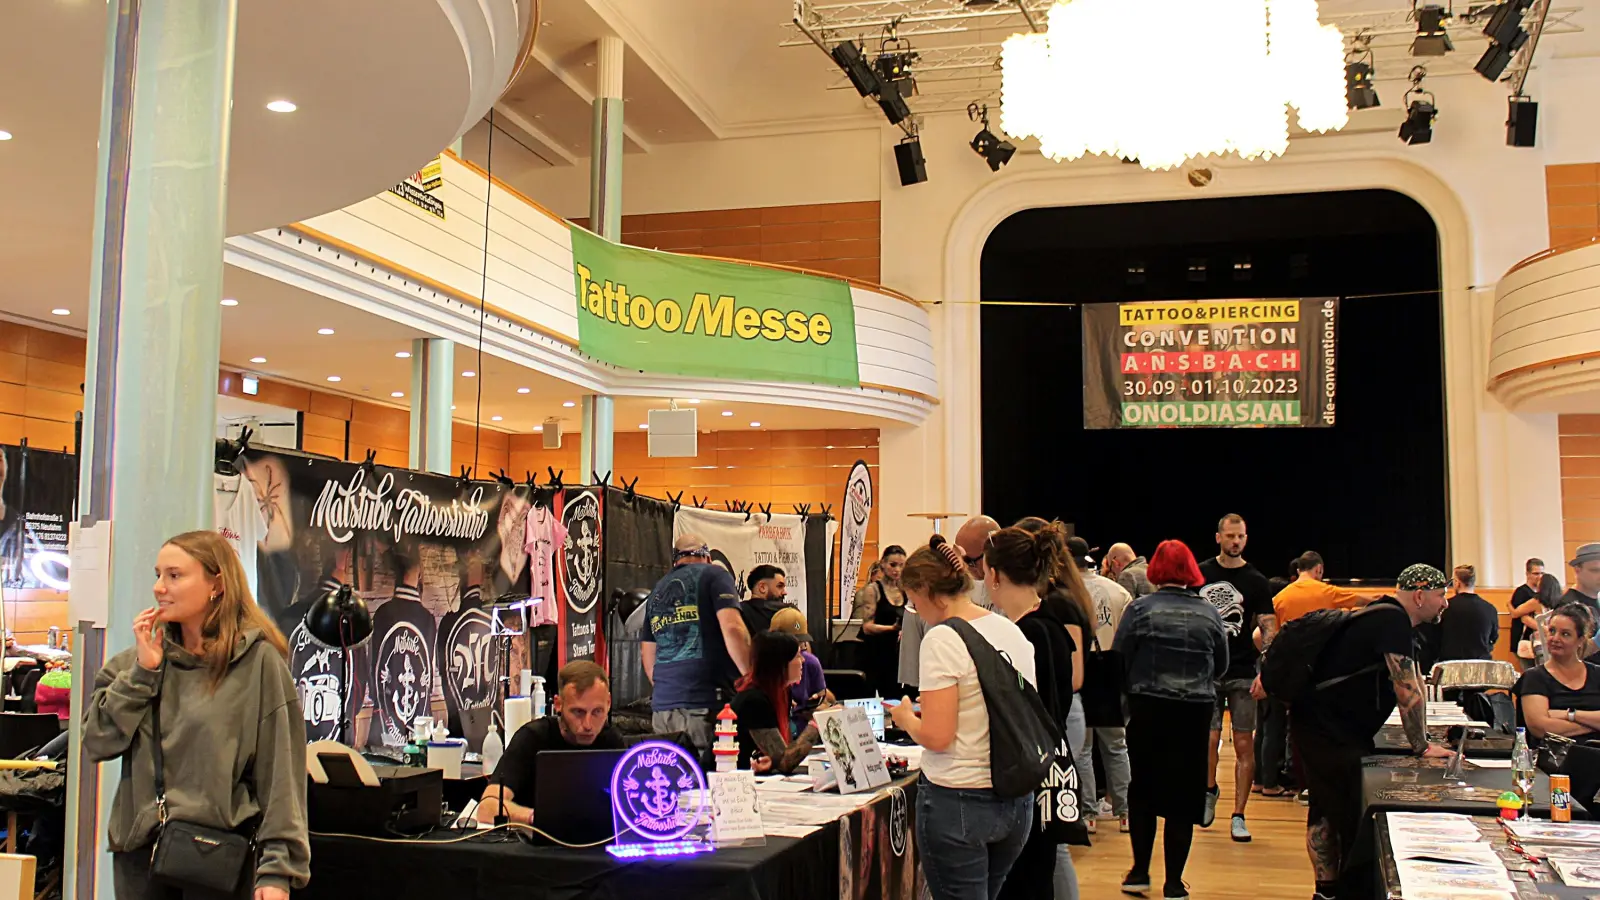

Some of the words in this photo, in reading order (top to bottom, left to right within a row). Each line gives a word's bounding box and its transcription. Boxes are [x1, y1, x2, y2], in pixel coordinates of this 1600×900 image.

[576, 262, 682, 333] Tattoo
[683, 292, 833, 345] Messe
[1123, 305, 1296, 320] TATTOO&PIERCING
[1123, 327, 1297, 347] CONVENTION
[1322, 301, 1335, 425] die-convention.de
[1123, 380, 1176, 396] 30.09
[1191, 378, 1298, 395] 01.10.2023
[1124, 403, 1300, 423] ONOLDIASAAL
[309, 468, 394, 543] Malstube
[393, 486, 489, 543] Tattoostudio
[754, 552, 773, 564] TATTOO
[773, 552, 778, 564] &
[571, 624, 589, 636] Tattoos
[573, 642, 587, 657] Steve
[637, 749, 677, 768] Malstube
[1036, 789, 1080, 822] 18
[1550, 792, 1570, 804] FANT
